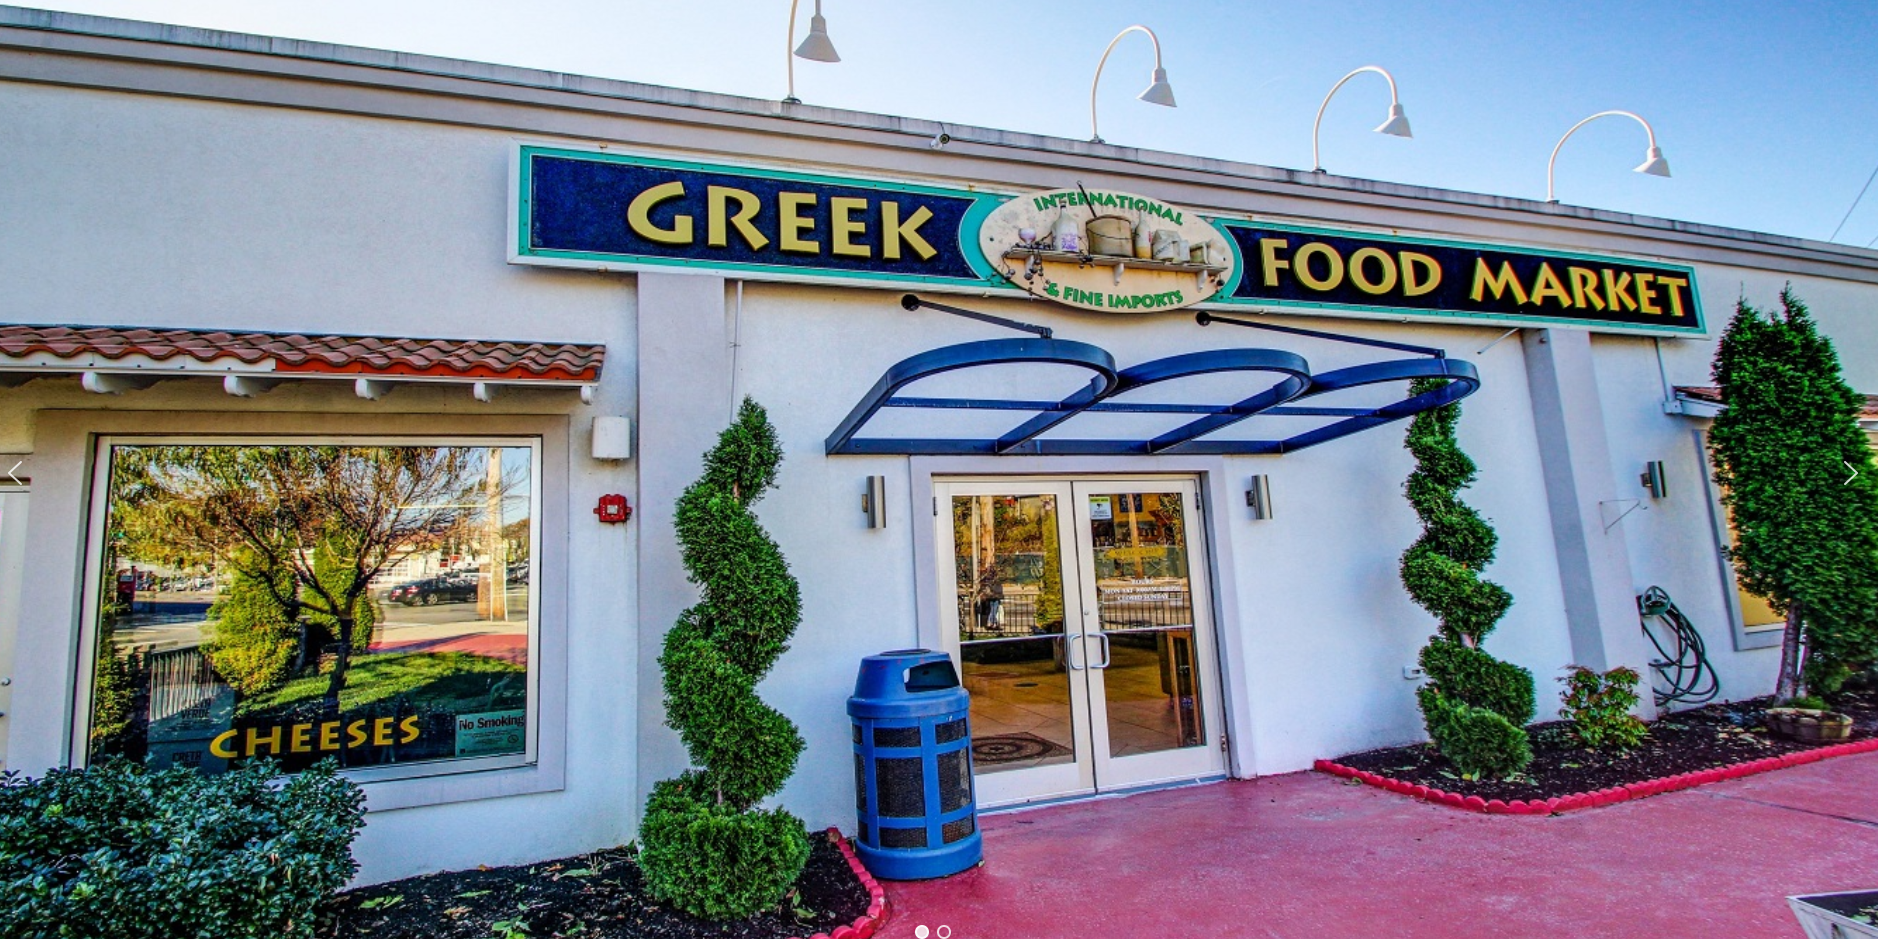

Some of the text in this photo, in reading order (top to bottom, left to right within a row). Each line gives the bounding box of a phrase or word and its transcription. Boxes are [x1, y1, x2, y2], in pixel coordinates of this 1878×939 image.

[626, 180, 938, 261] GREEK
[1045, 282, 1184, 309] & FINE IMPORTS
[1260, 237, 1689, 318] FOOD MARKET
[209, 714, 421, 758] CHEESES
[459, 714, 525, 731] No Smoking
